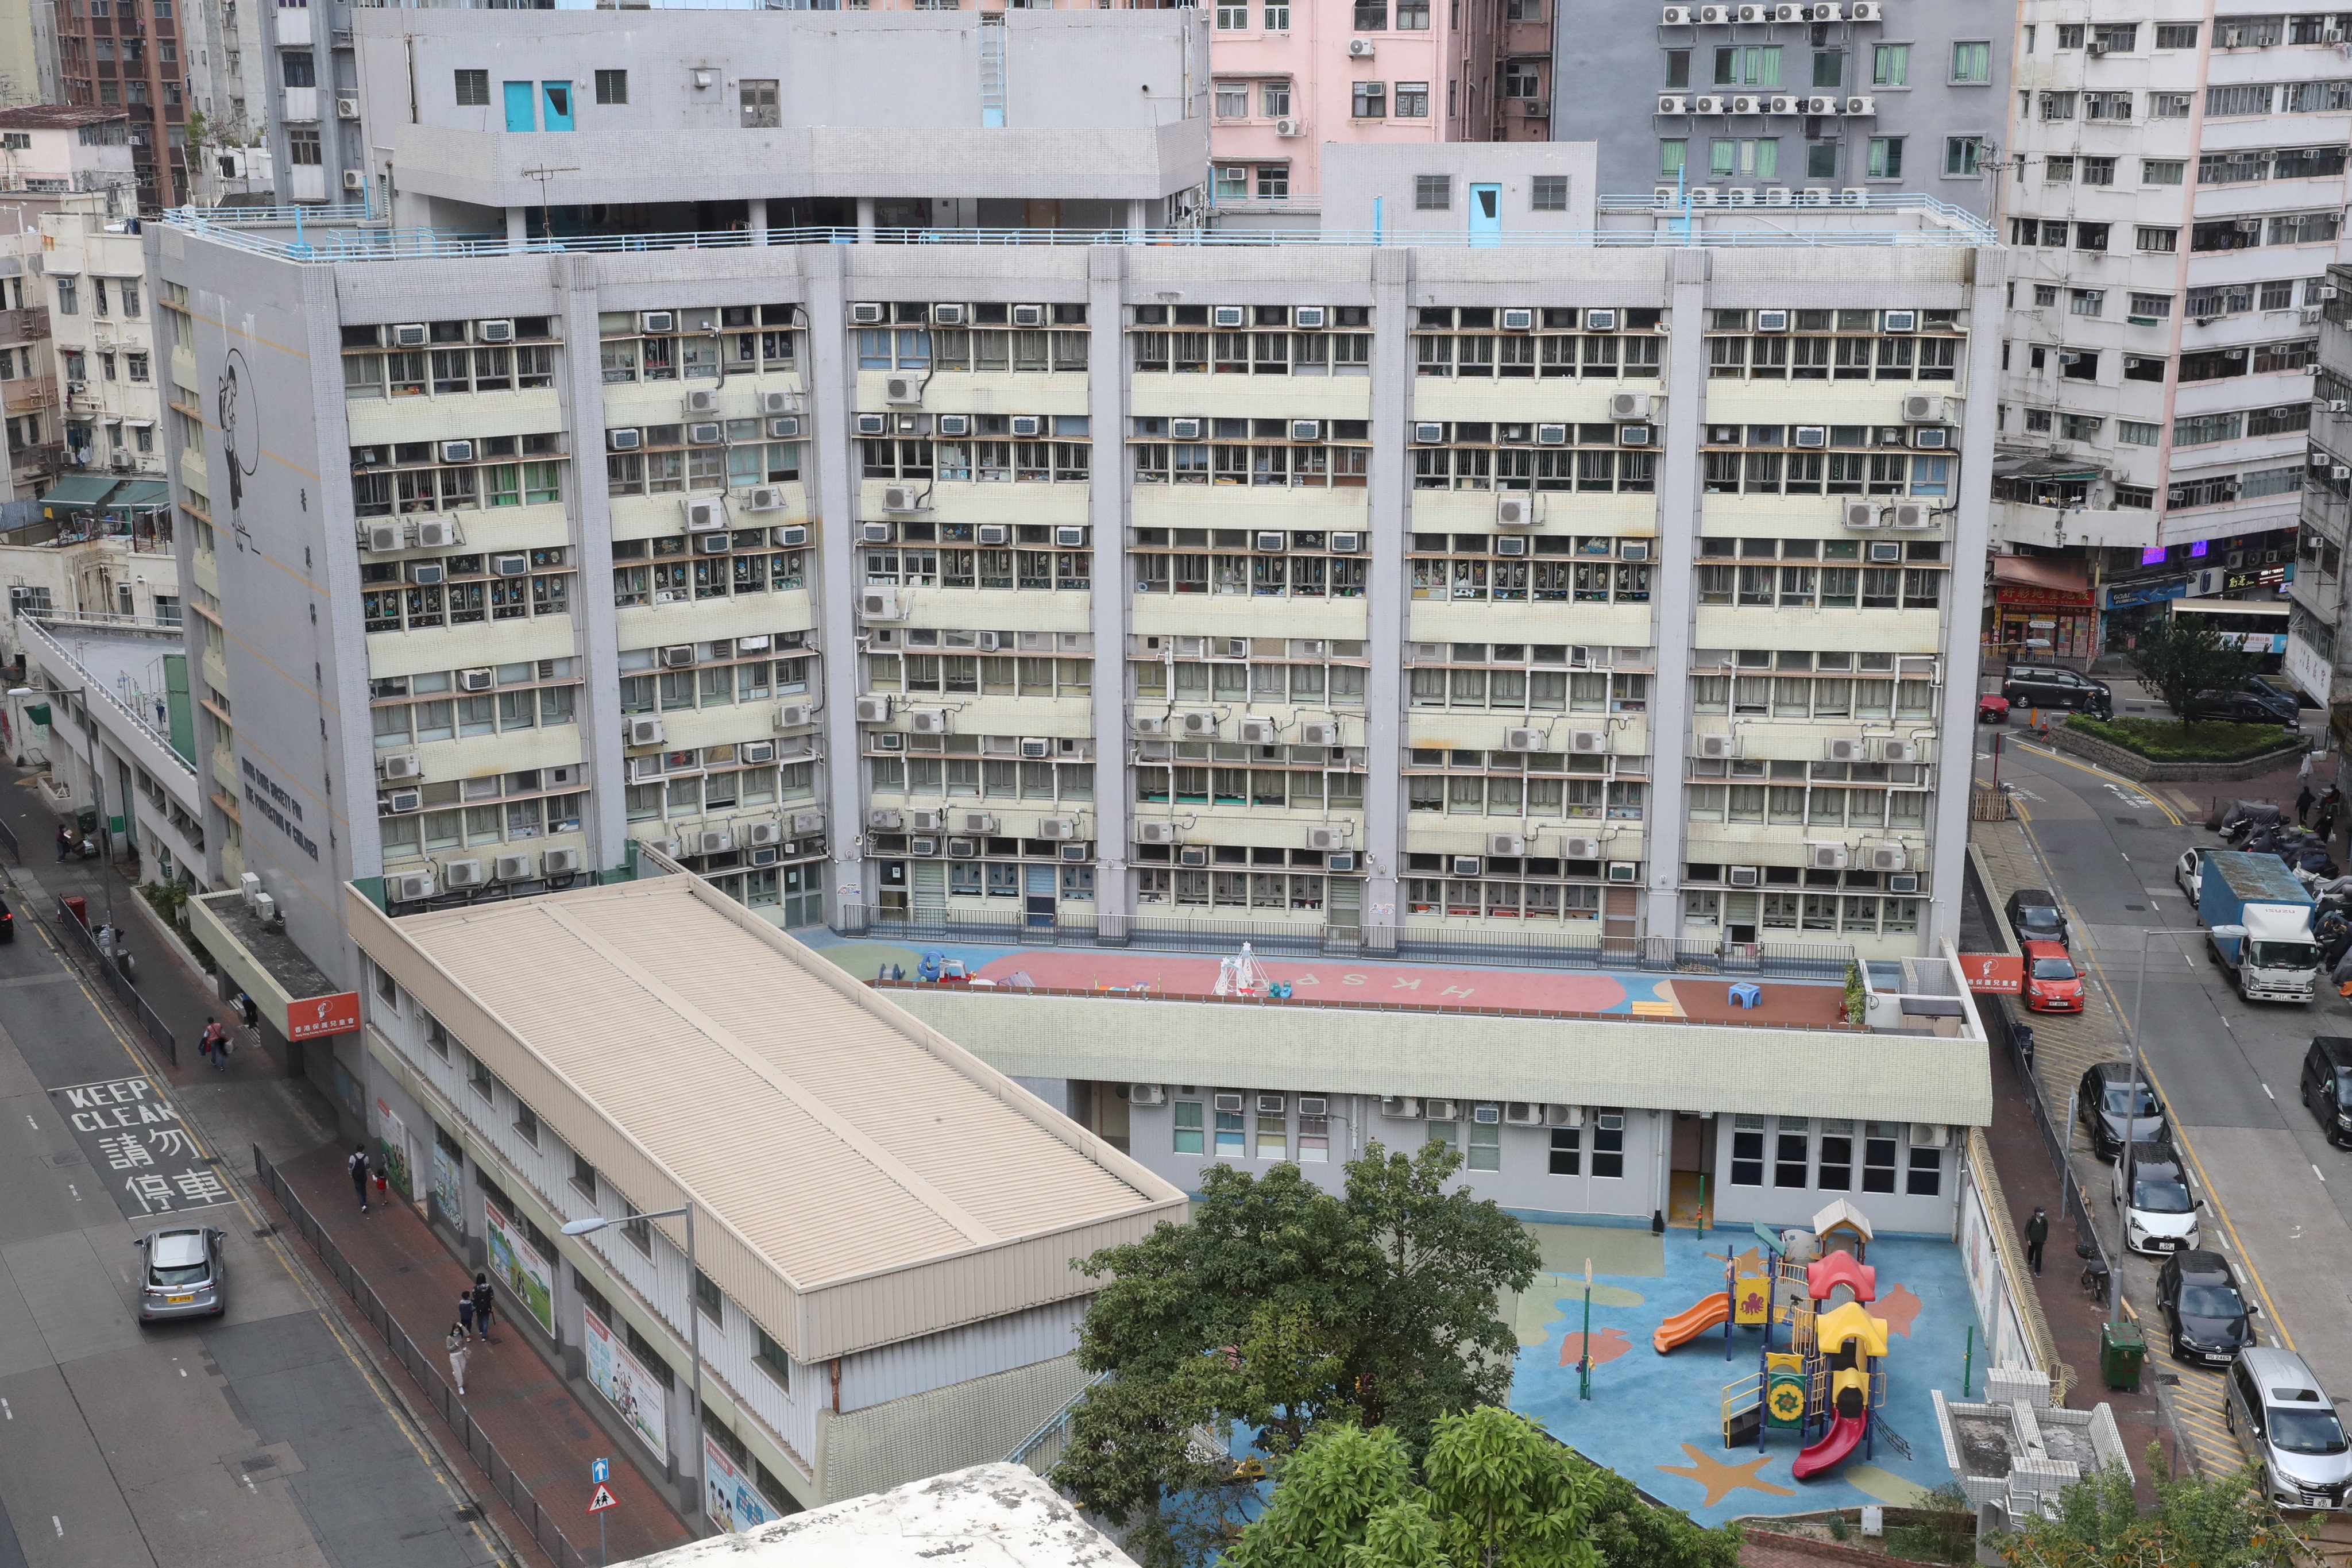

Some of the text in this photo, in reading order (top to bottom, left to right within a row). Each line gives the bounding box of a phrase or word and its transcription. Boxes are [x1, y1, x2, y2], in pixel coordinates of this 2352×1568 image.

[2113, 592, 2131, 600] GOAL
[65, 1080, 149, 1108] KEEP
[71, 1099, 181, 1131] CLEAR
[98, 1129, 200, 1169] 請勿
[125, 1168, 227, 1212] 停車
